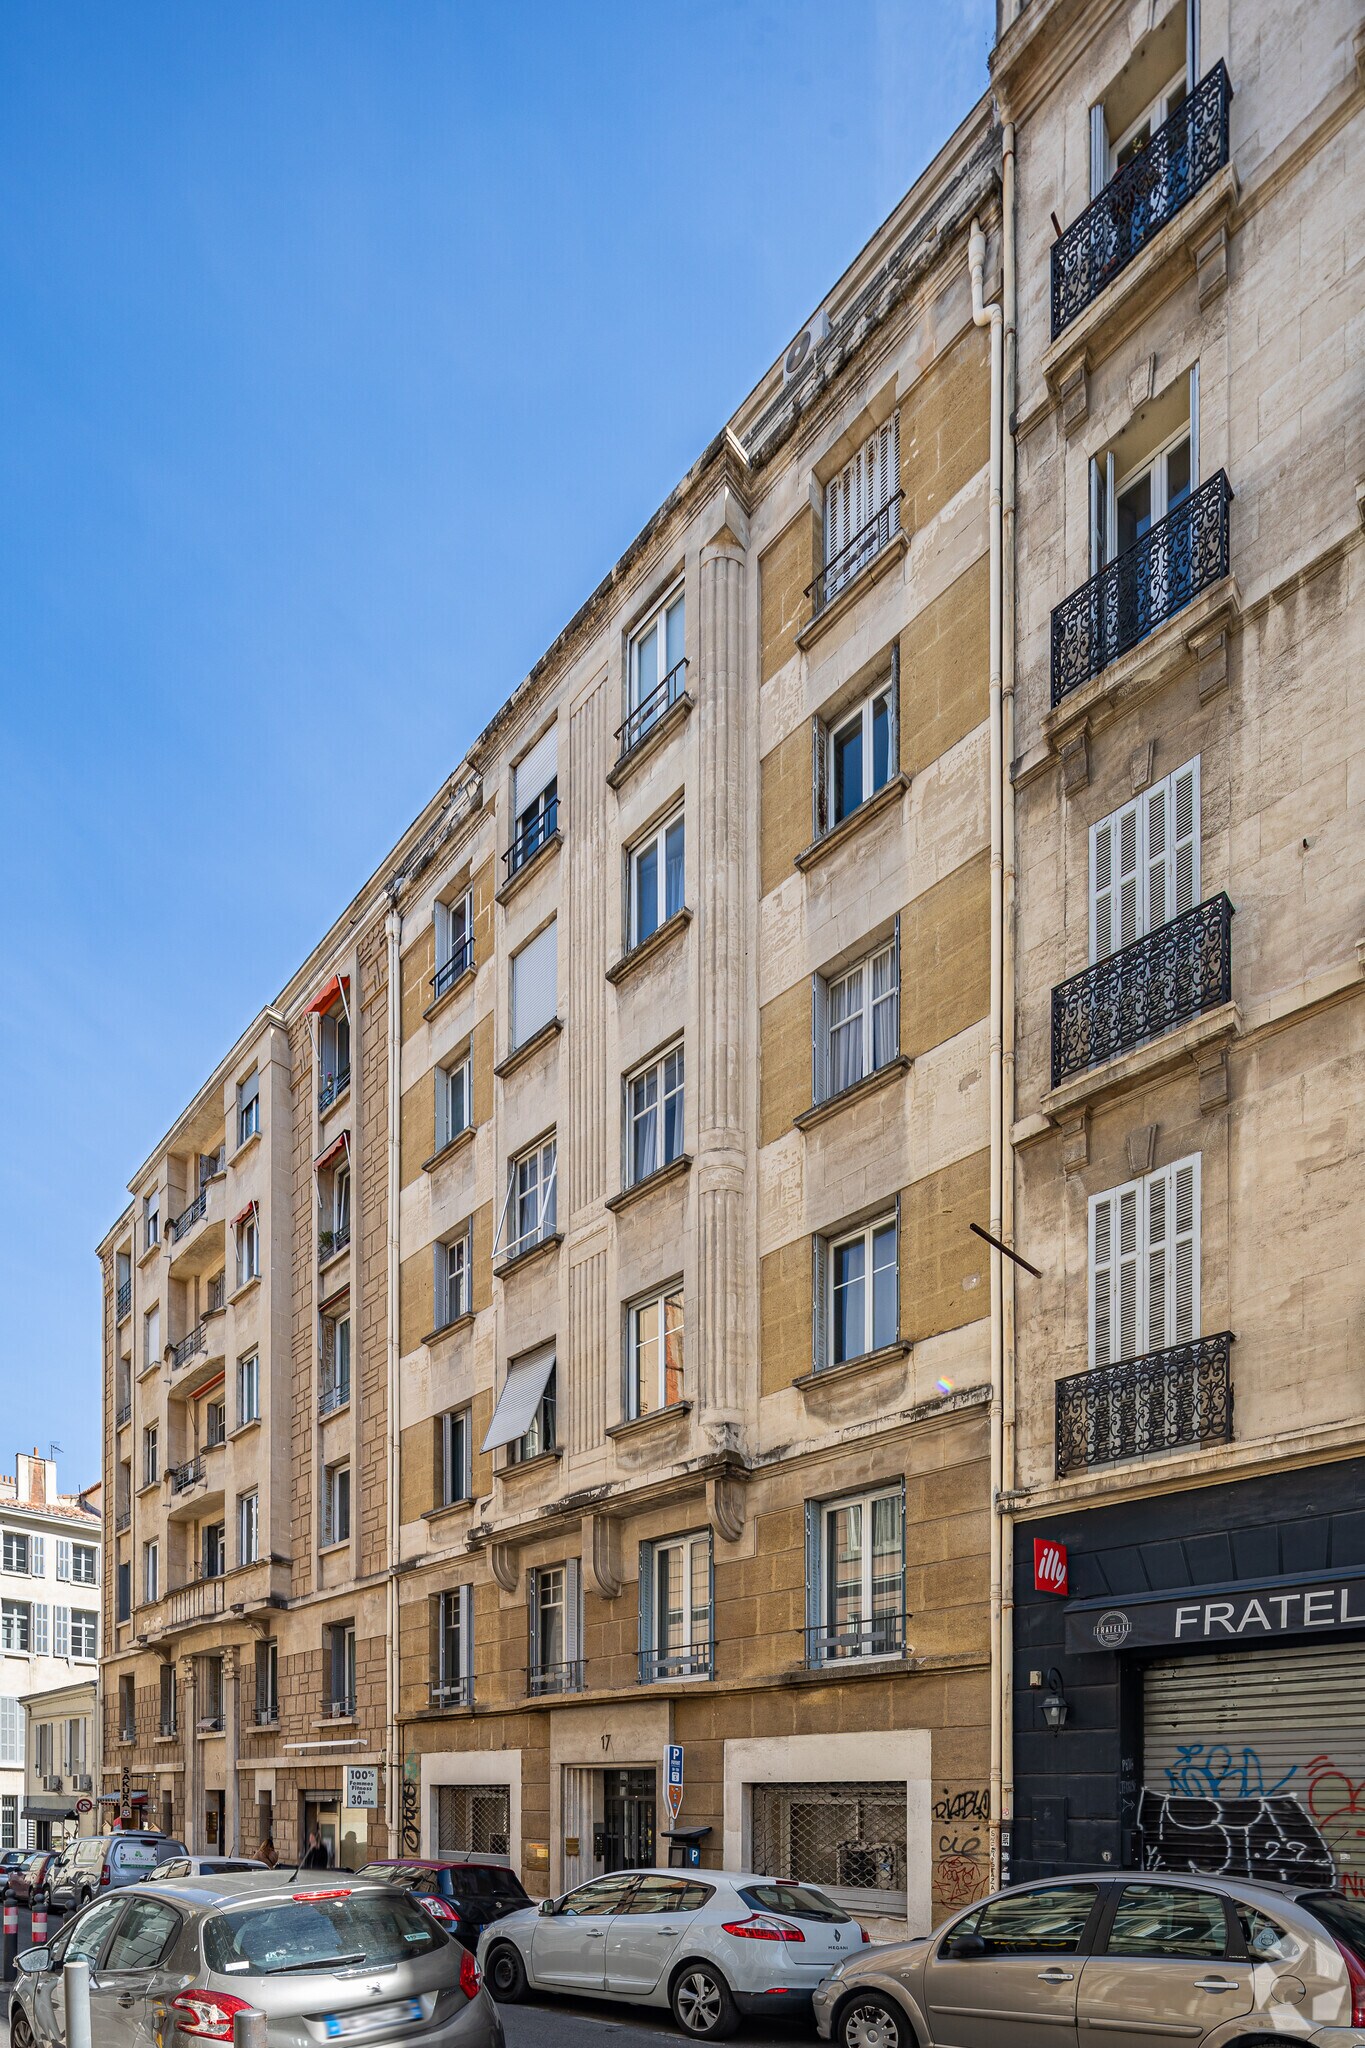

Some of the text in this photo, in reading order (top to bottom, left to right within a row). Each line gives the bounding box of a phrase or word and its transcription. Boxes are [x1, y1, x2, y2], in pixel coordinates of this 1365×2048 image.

[1038, 1547, 1066, 1589] illy
[1096, 1624, 1129, 1635] FRATELLI
[600, 1734, 611, 1751] 17
[673, 1748, 680, 1759] P
[350, 1770, 374, 1780] 100%
[122, 1767, 130, 1807] SAKURA
[351, 1795, 362, 1805] 30
[691, 1850, 698, 1861] P
